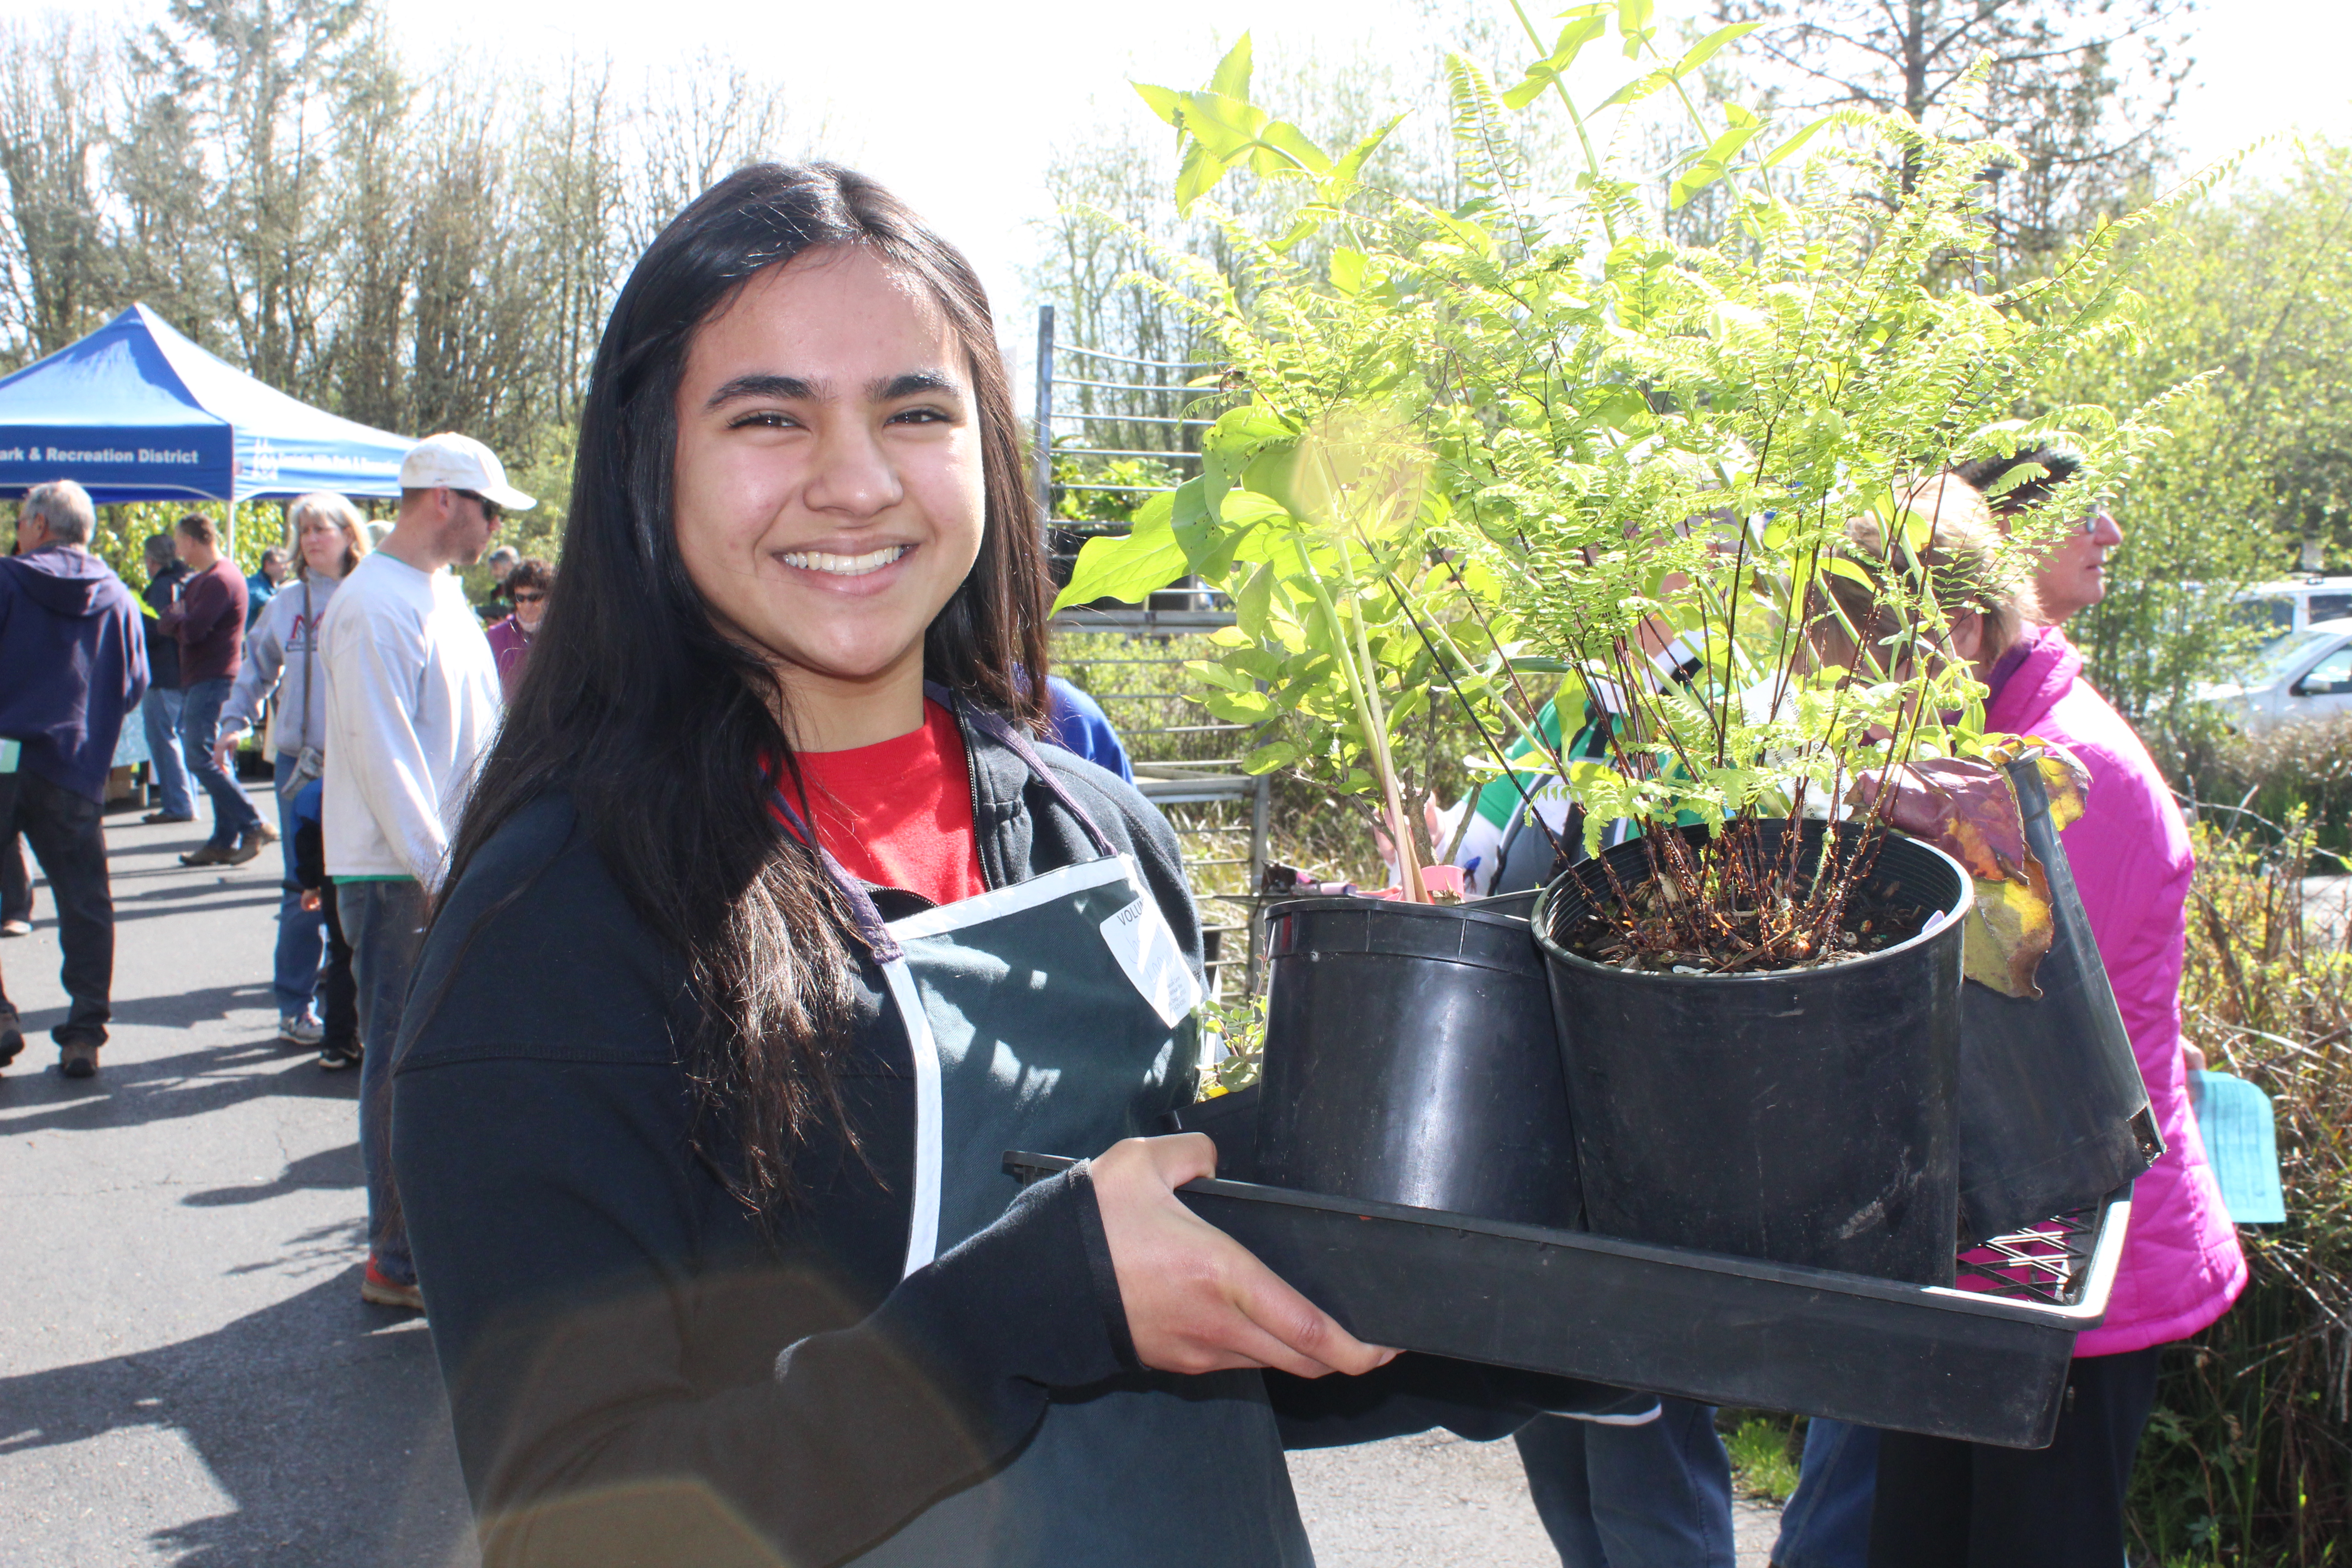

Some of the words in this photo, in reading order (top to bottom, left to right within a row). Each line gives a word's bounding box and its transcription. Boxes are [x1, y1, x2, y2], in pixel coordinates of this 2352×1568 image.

[29, 446, 42, 461] &
[46, 447, 135, 463] Recreation
[138, 448, 200, 465] District
